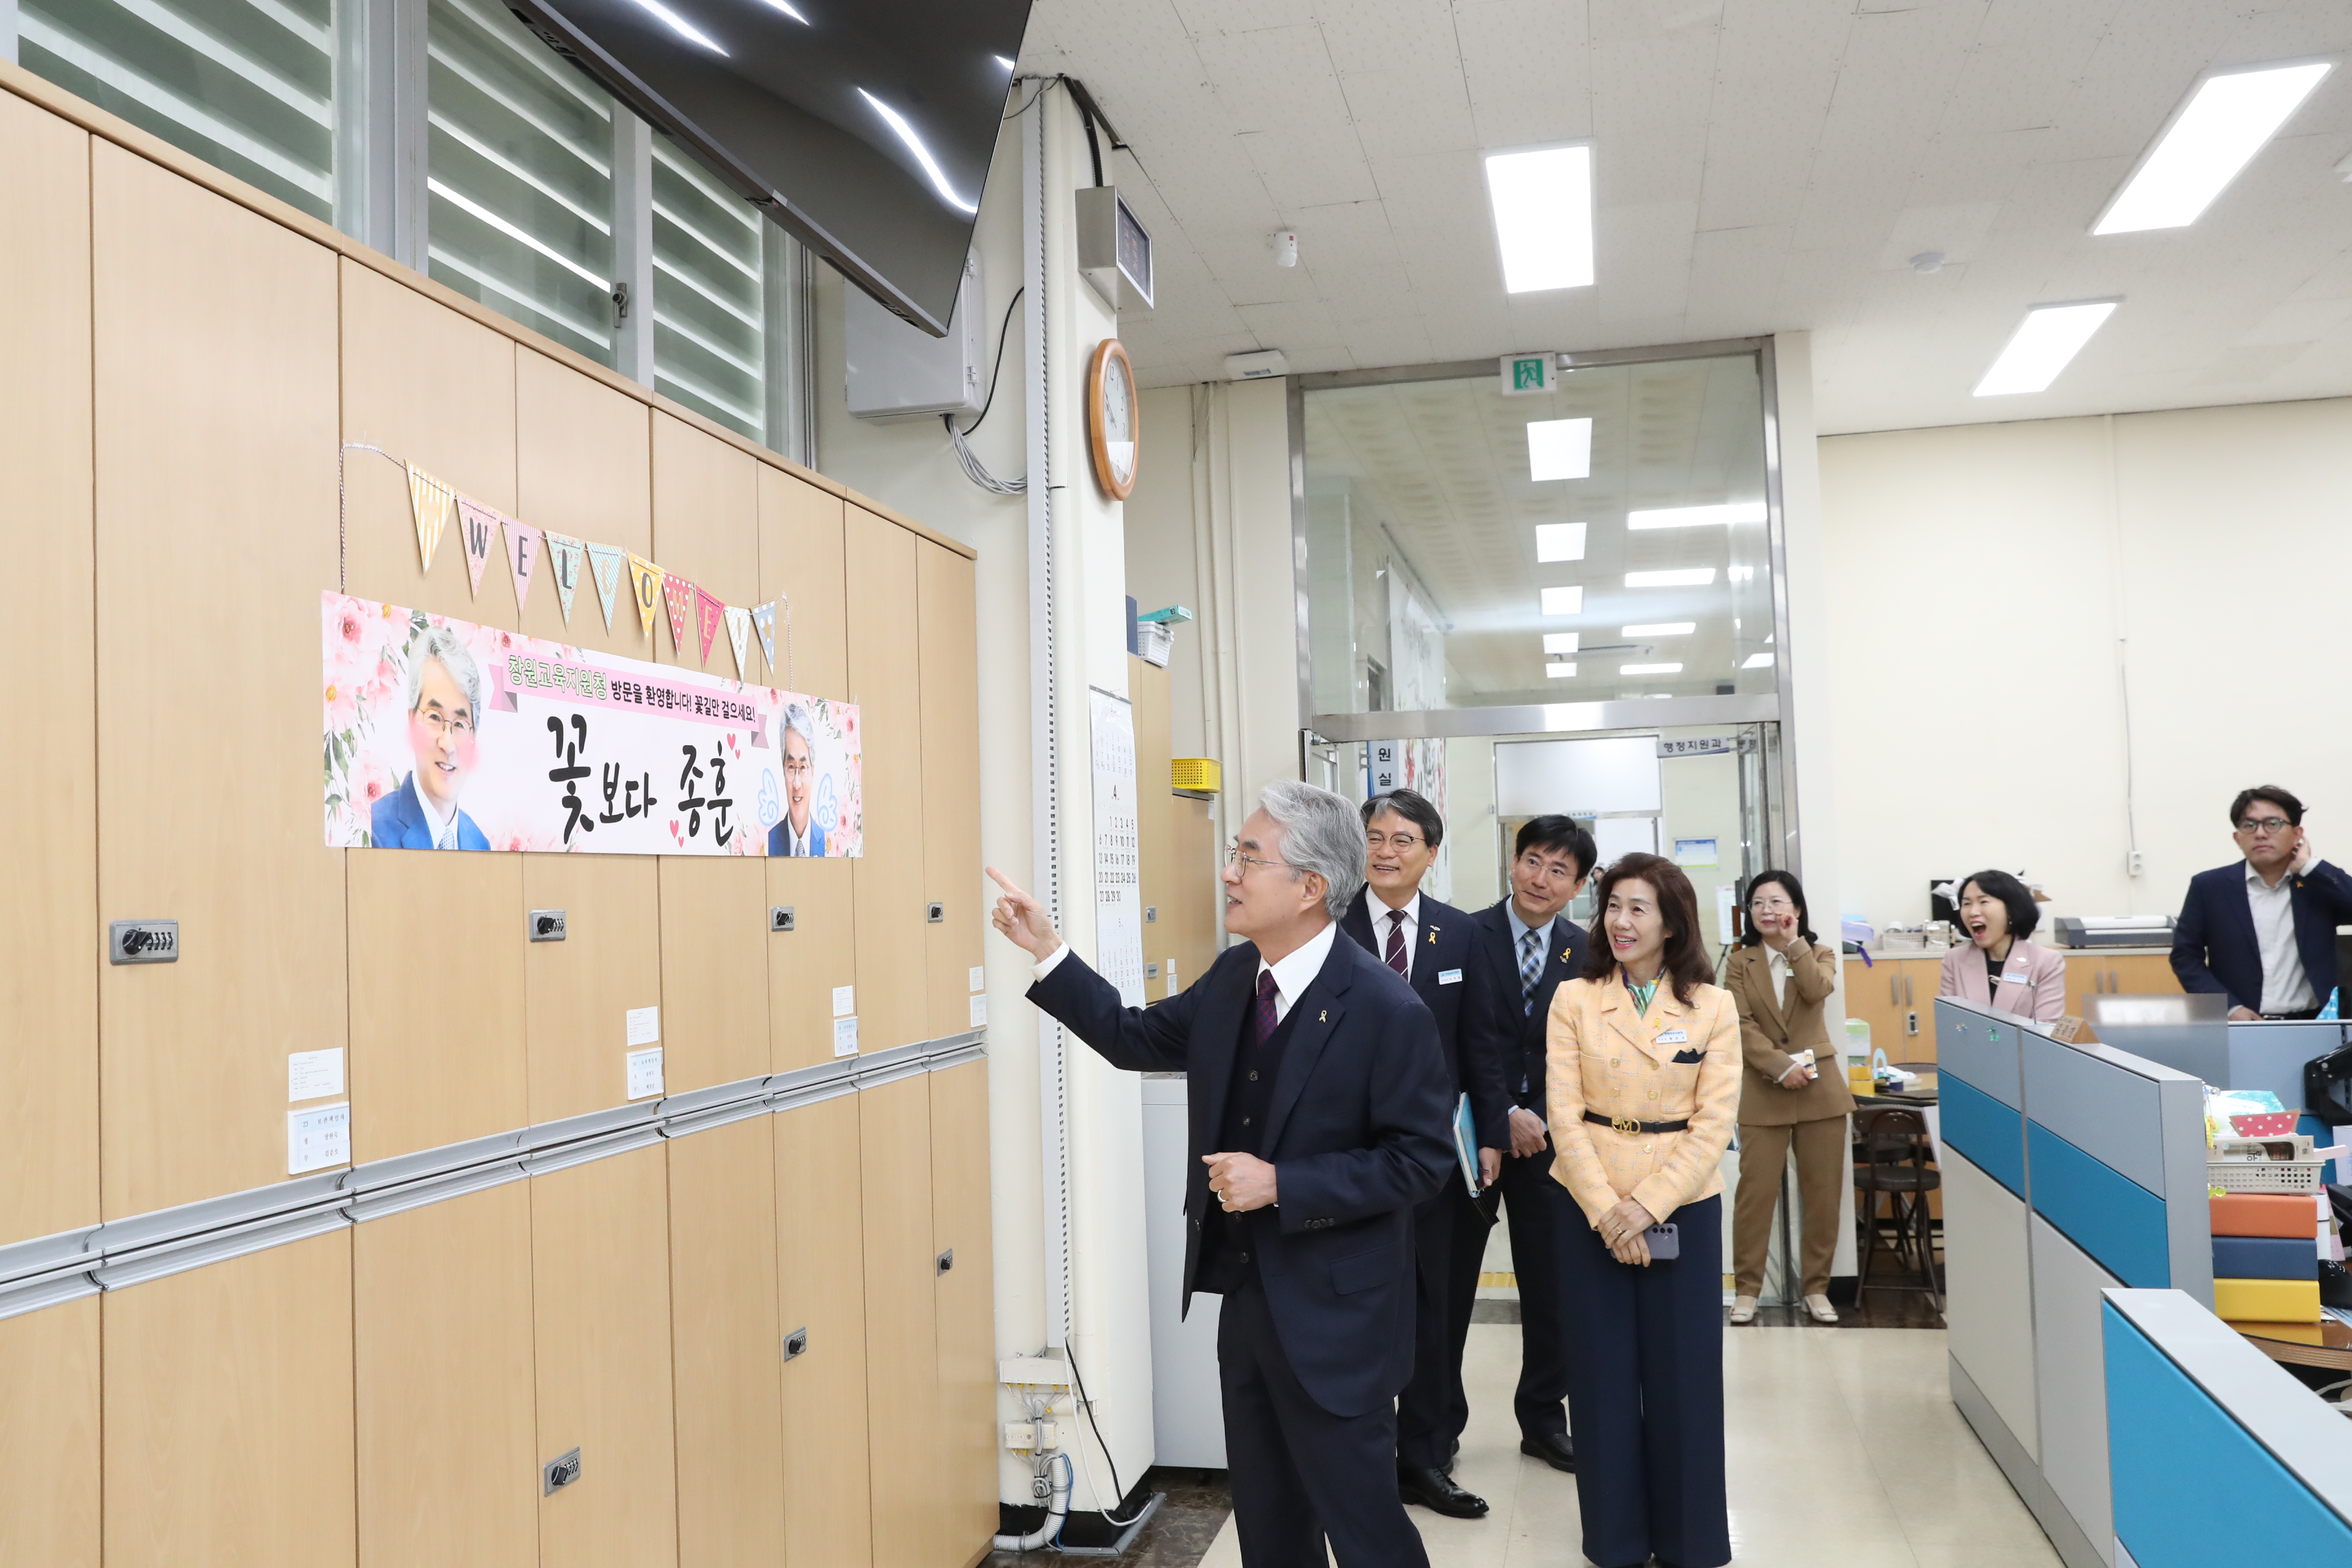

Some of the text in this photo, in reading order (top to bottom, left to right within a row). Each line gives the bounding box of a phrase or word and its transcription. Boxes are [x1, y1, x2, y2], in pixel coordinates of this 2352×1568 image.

[1110, 364, 1114, 381] 12
[1122, 422, 1126, 438] 3
[509, 654, 756, 723] 창원교육지원청 방문을 환영합니다! 꽃길만 걸으세요!
[1663, 739, 1721, 753] 행정지원과
[678, 740, 734, 847] 종훈
[1113, 785, 1117, 800] 4
[1120, 836, 1124, 847] 10
[1126, 836, 1130, 847] 11
[1132, 837, 1135, 848] 12
[1099, 852, 1135, 865] 13 14 15 16 17 18 19
[1099, 872, 1136, 883] 20 21 22 23 24 25 26
[1099, 890, 1121, 902] 27 28 29 30
